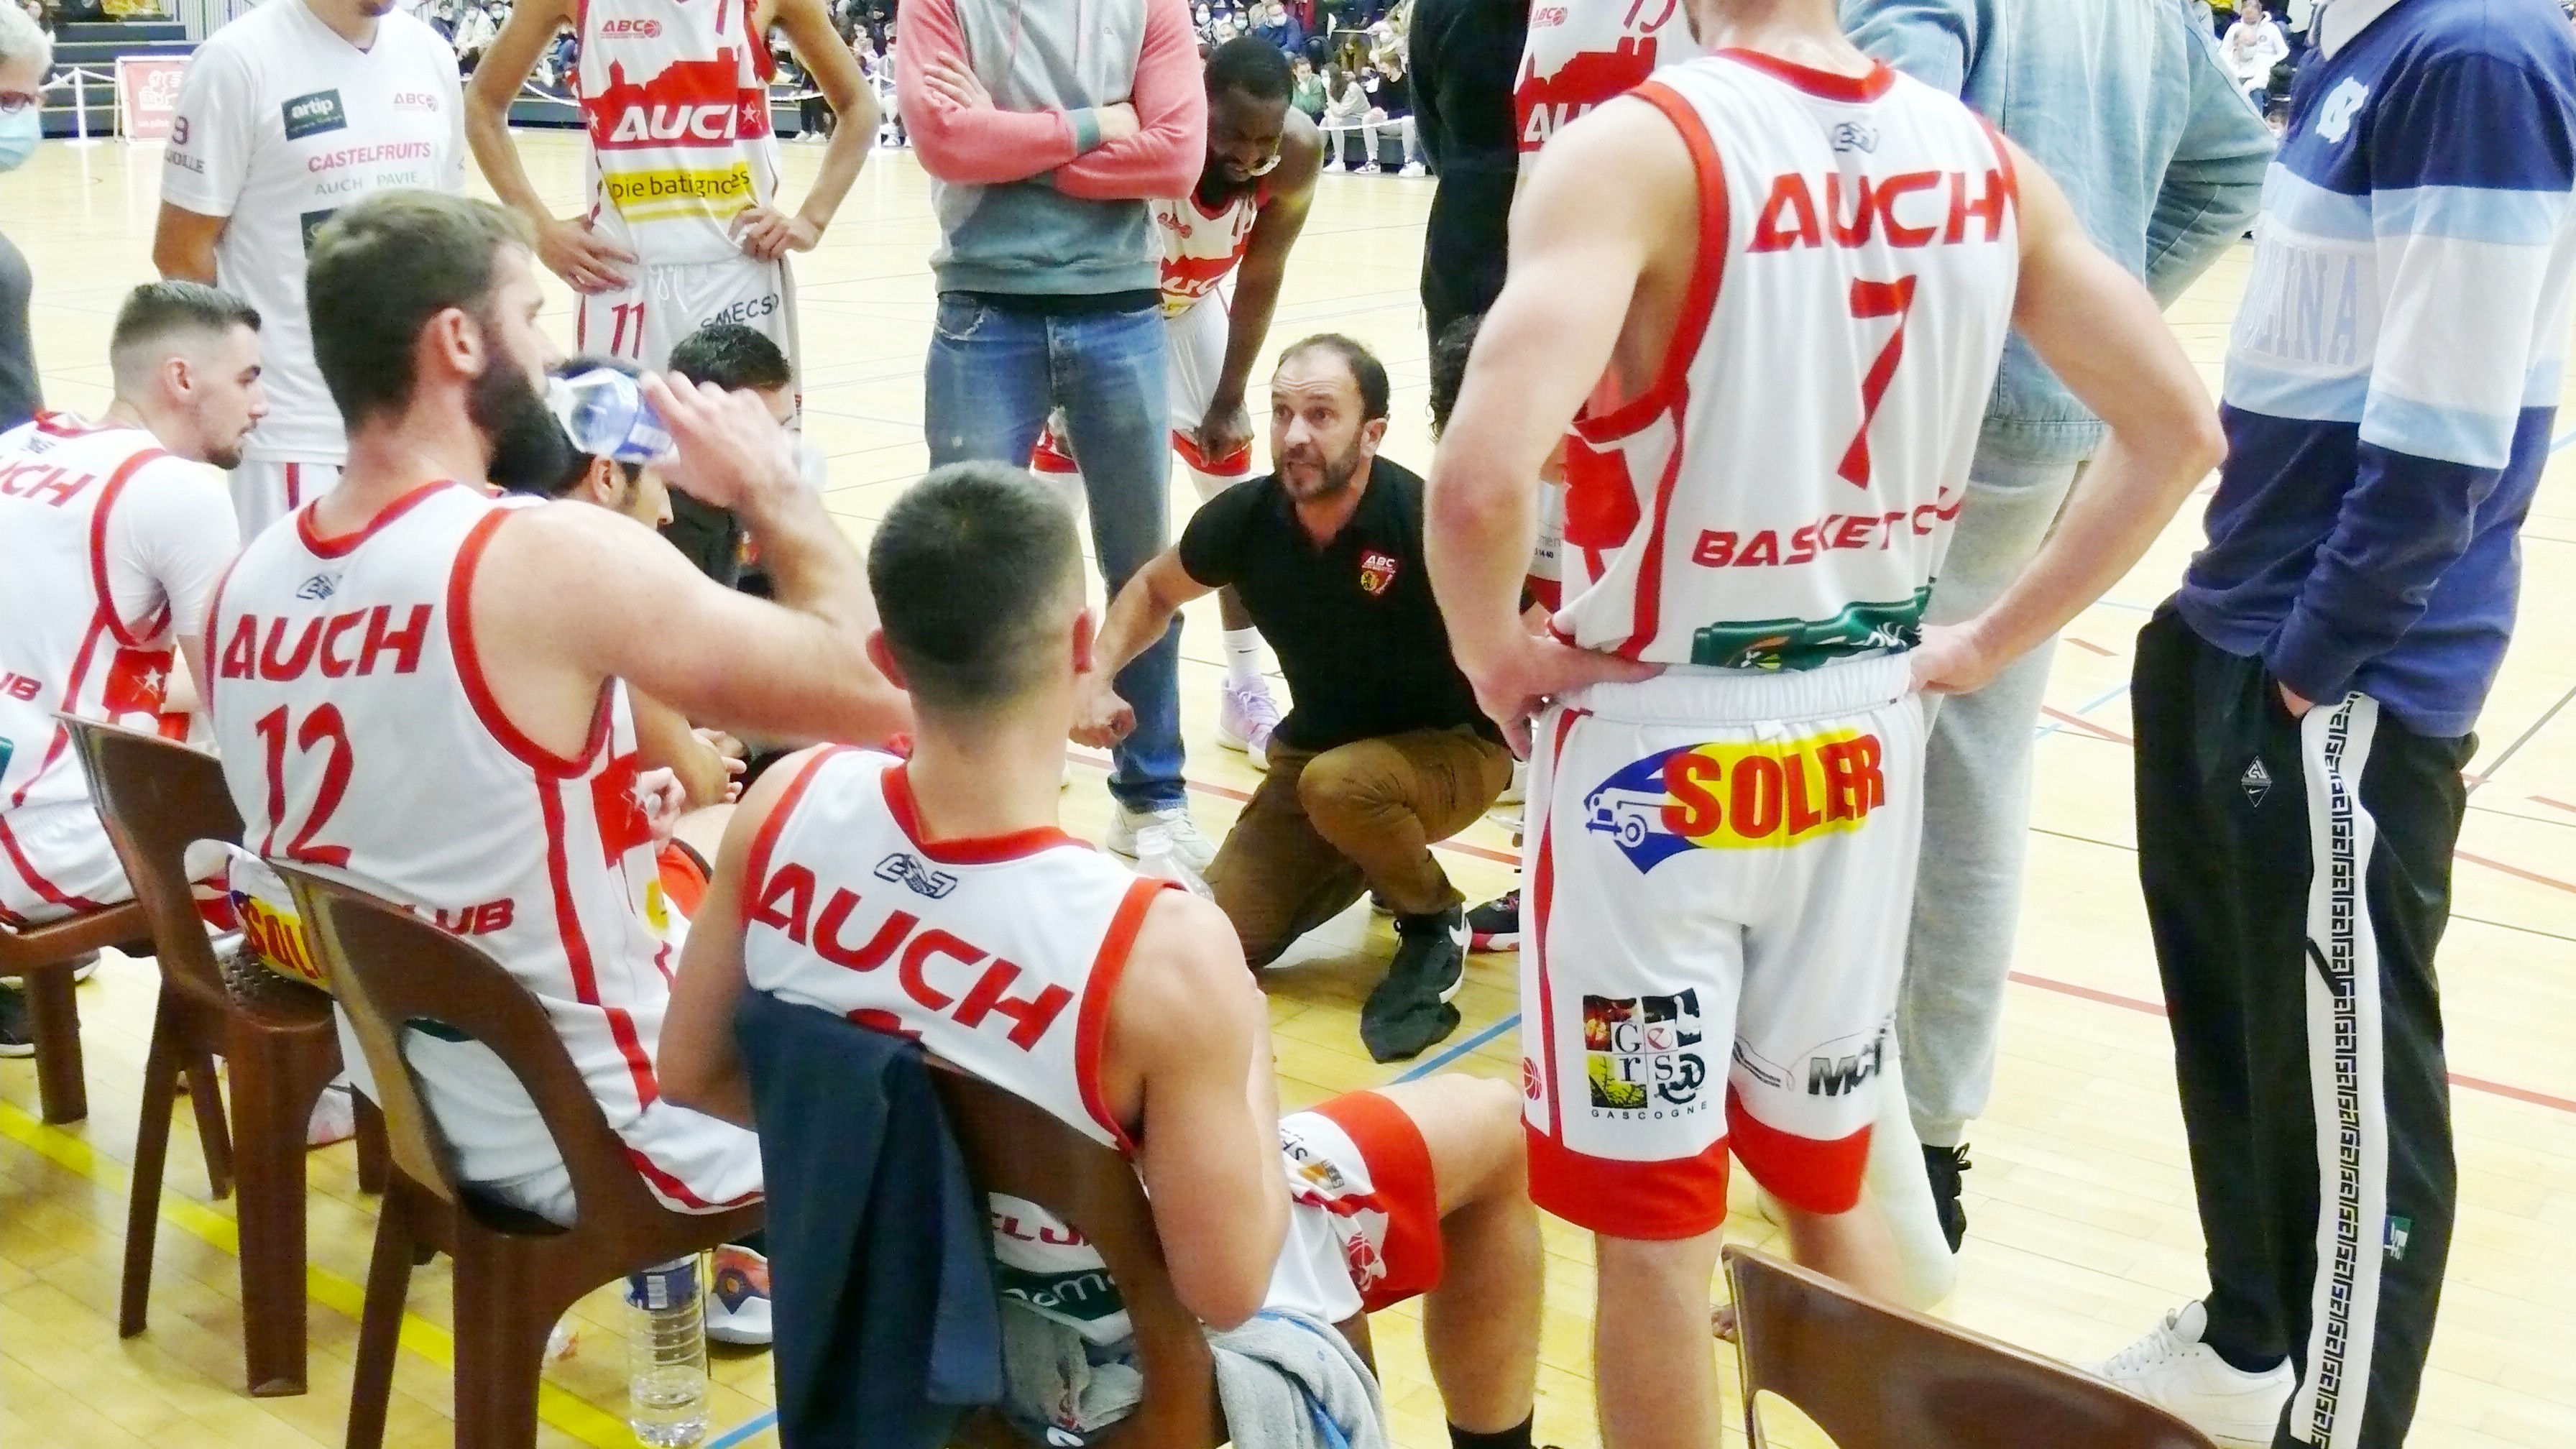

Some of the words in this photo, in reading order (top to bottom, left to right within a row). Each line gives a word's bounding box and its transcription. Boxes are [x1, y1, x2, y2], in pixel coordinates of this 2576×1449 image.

[602, 19, 645, 32] ABC
[291, 97, 334, 119] artip
[394, 93, 427, 104] ABC
[308, 142, 431, 173] CASTELFRUITS
[314, 177, 363, 196] AUCH
[377, 171, 419, 187] PAVIE
[1745, 169, 2007, 254] AUCH
[611, 302, 645, 360] 11
[1836, 274, 1918, 491] 7
[1363, 555, 1396, 568] ABC
[221, 604, 434, 682] AUCH
[255, 701, 354, 870] 12
[1660, 733, 1885, 839] SOLER
[400, 898, 515, 936] UB
[750, 862, 1075, 1052] AUCH
[1591, 1100, 1708, 1120] GASCOGNE
